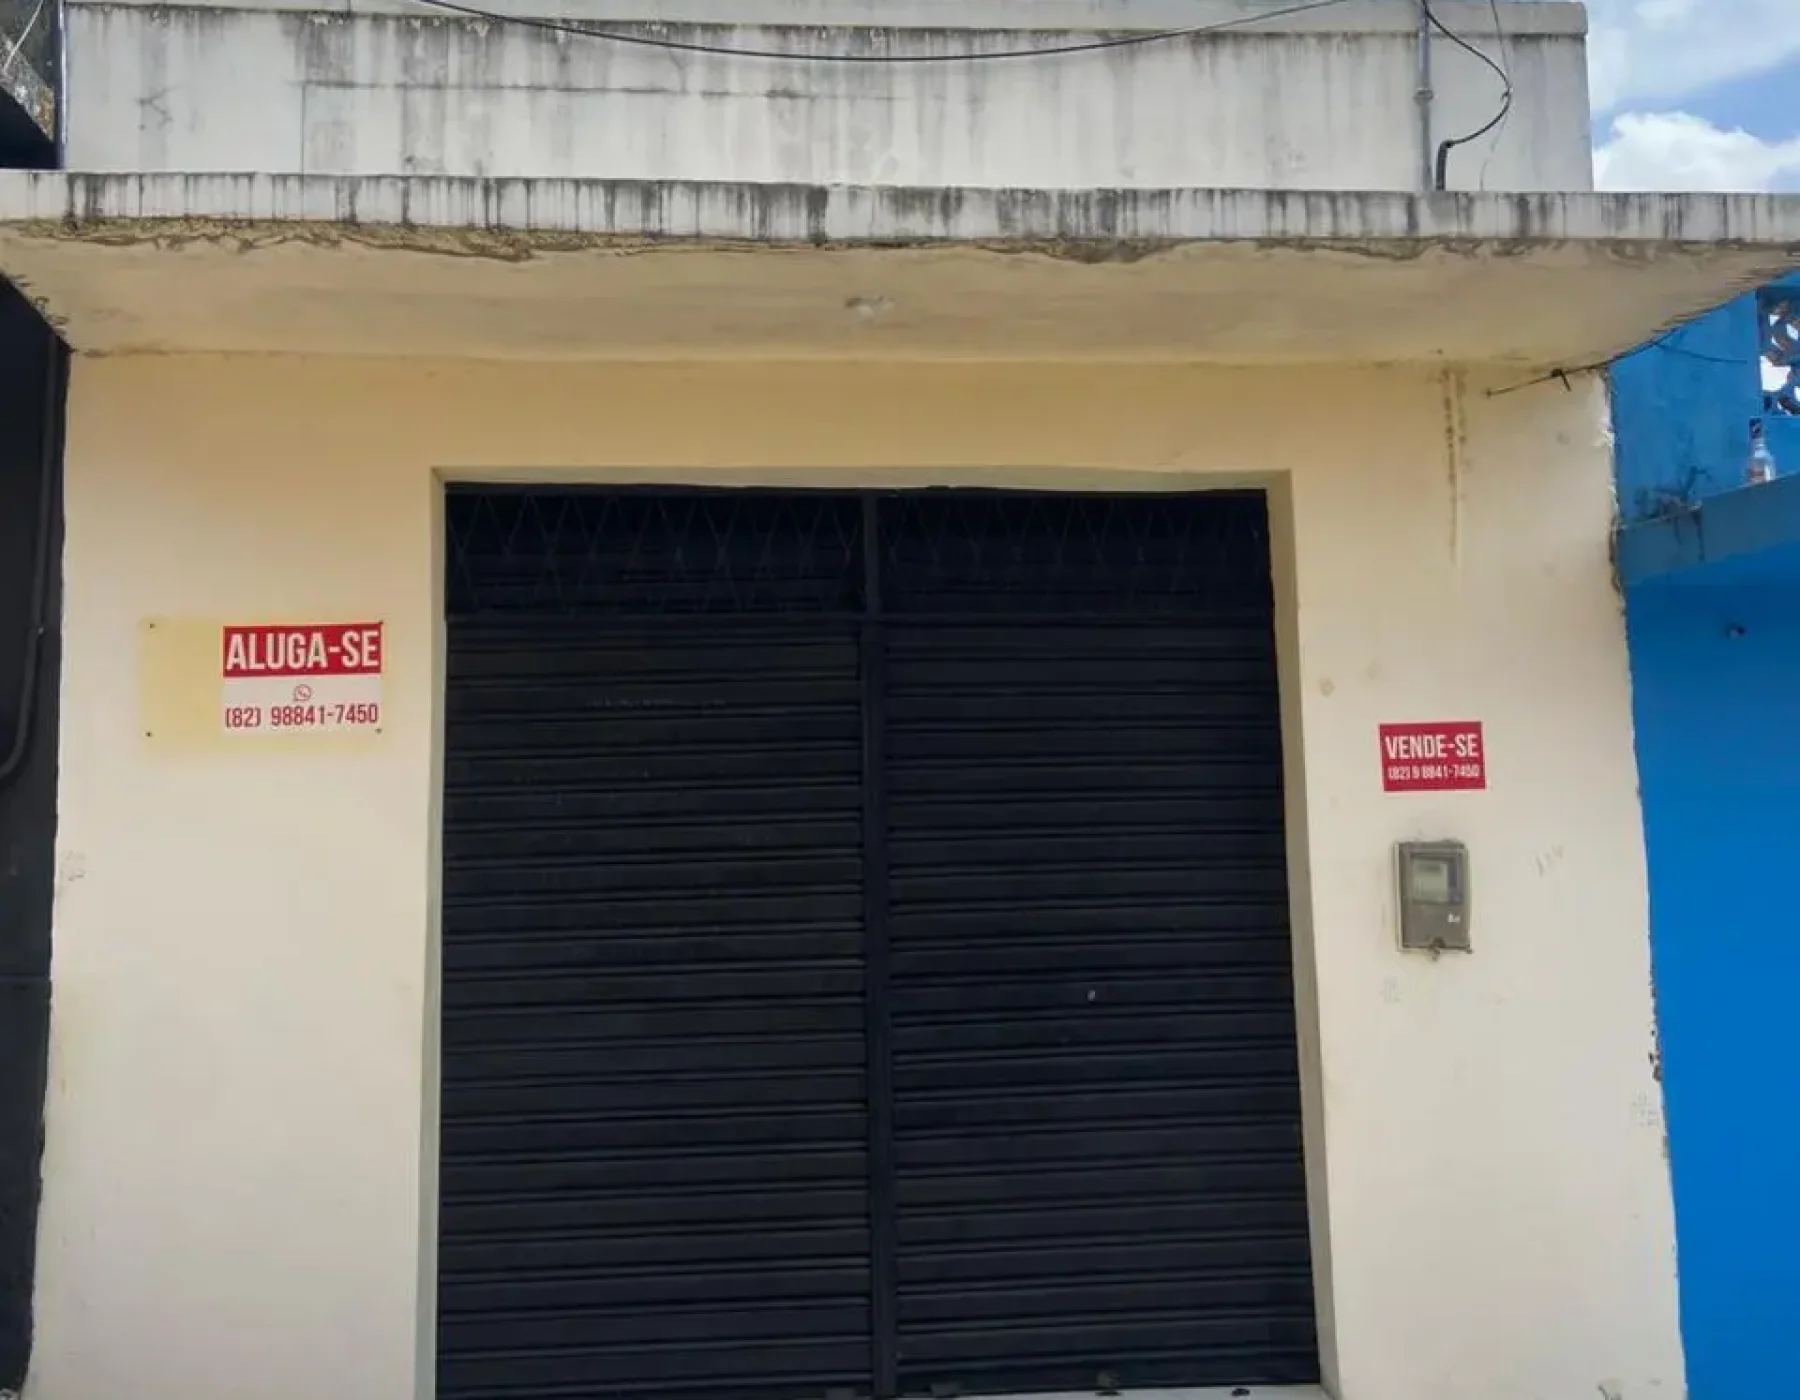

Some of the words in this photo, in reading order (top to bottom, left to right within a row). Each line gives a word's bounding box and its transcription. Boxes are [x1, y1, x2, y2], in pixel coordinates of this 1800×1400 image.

[226, 631, 380, 670] ALUGA-SE
[225, 707, 261, 728] (82)
[270, 704, 378, 725] 98841-7450
[1385, 733, 1479, 759] VENDE-SE
